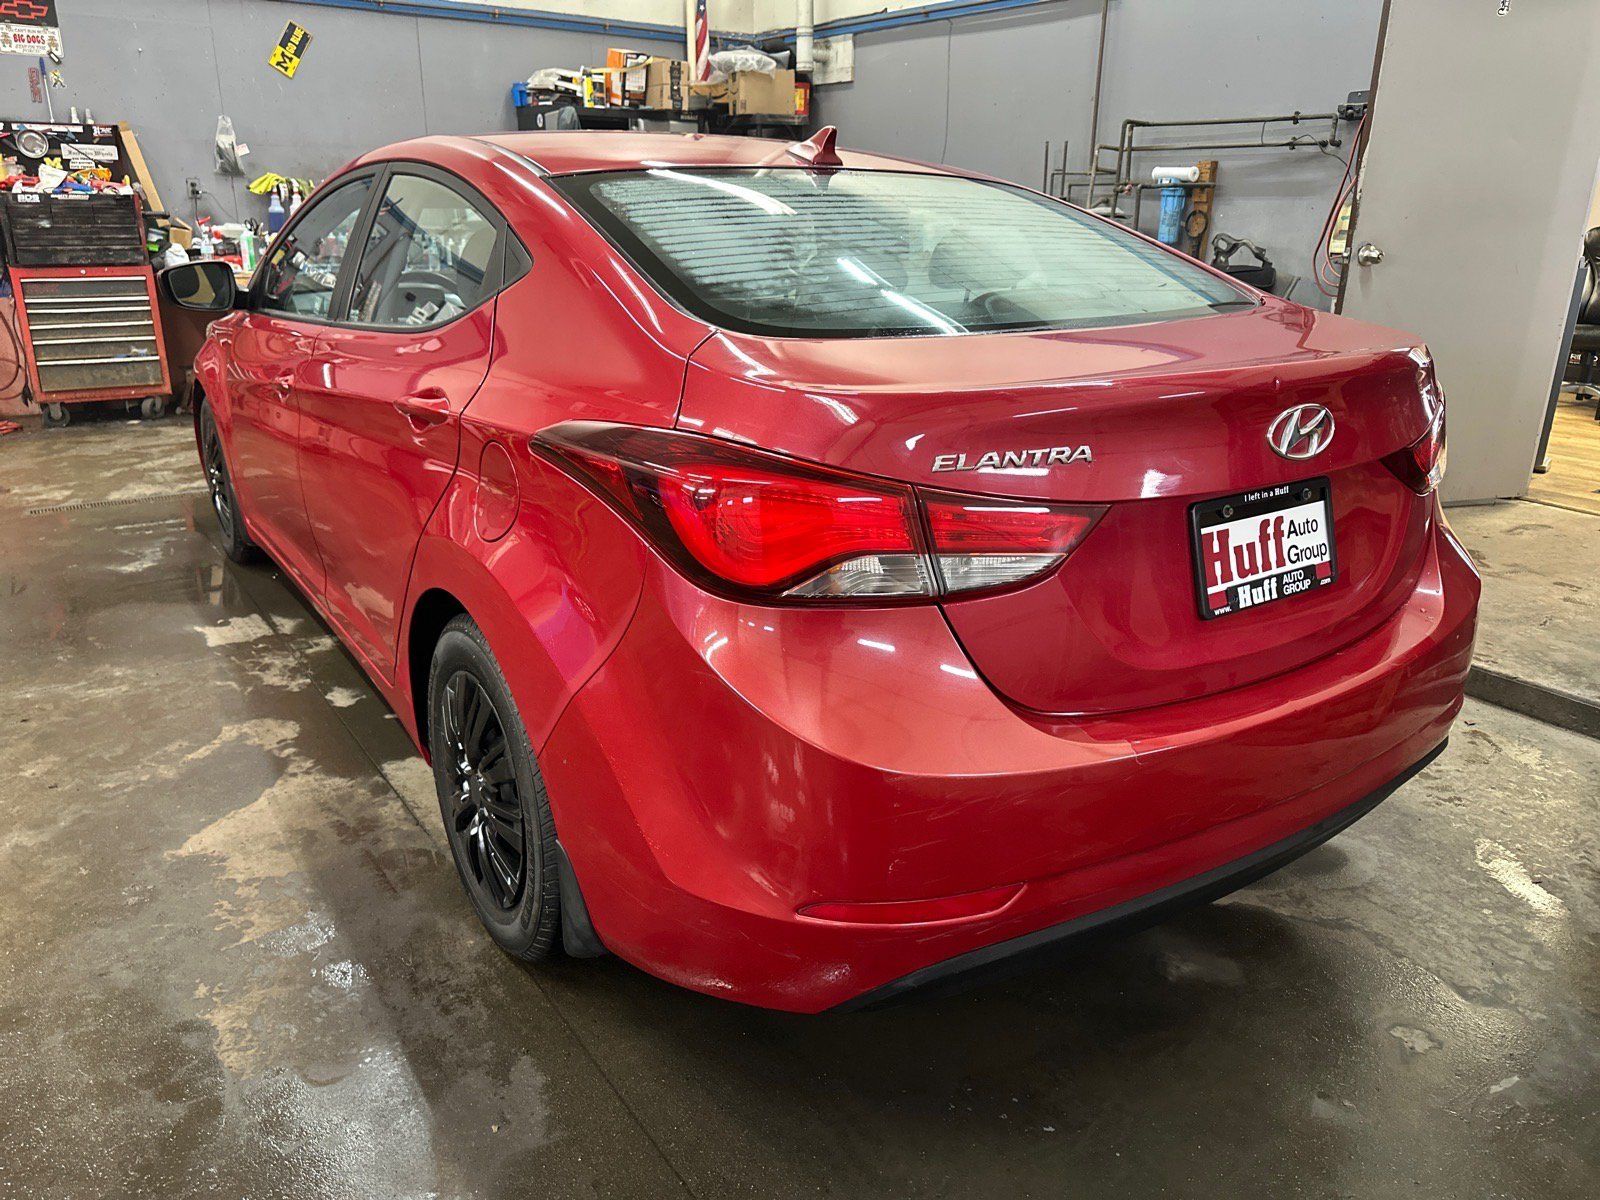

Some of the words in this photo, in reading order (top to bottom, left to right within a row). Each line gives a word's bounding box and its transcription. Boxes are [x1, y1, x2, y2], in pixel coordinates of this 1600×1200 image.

[13, 33, 25, 43] BIG
[26, 34, 46, 45] DOGS
[290, 26, 305, 45] BLUE
[285, 42, 297, 54] GO
[276, 51, 294, 72] M
[932, 445, 1094, 473] ELANTRA
[1248, 491, 1261, 502] left
[1262, 490, 1269, 498] in
[1274, 486, 1290, 496] Huff
[1202, 516, 1286, 588] Huff
[1287, 517, 1319, 539] Auto
[1287, 542, 1328, 566] Group
[1214, 606, 1232, 616] www.
[1237, 577, 1278, 609] Huff
[1282, 569, 1305, 585] AUTO
[1283, 579, 1312, 596] GROUP
